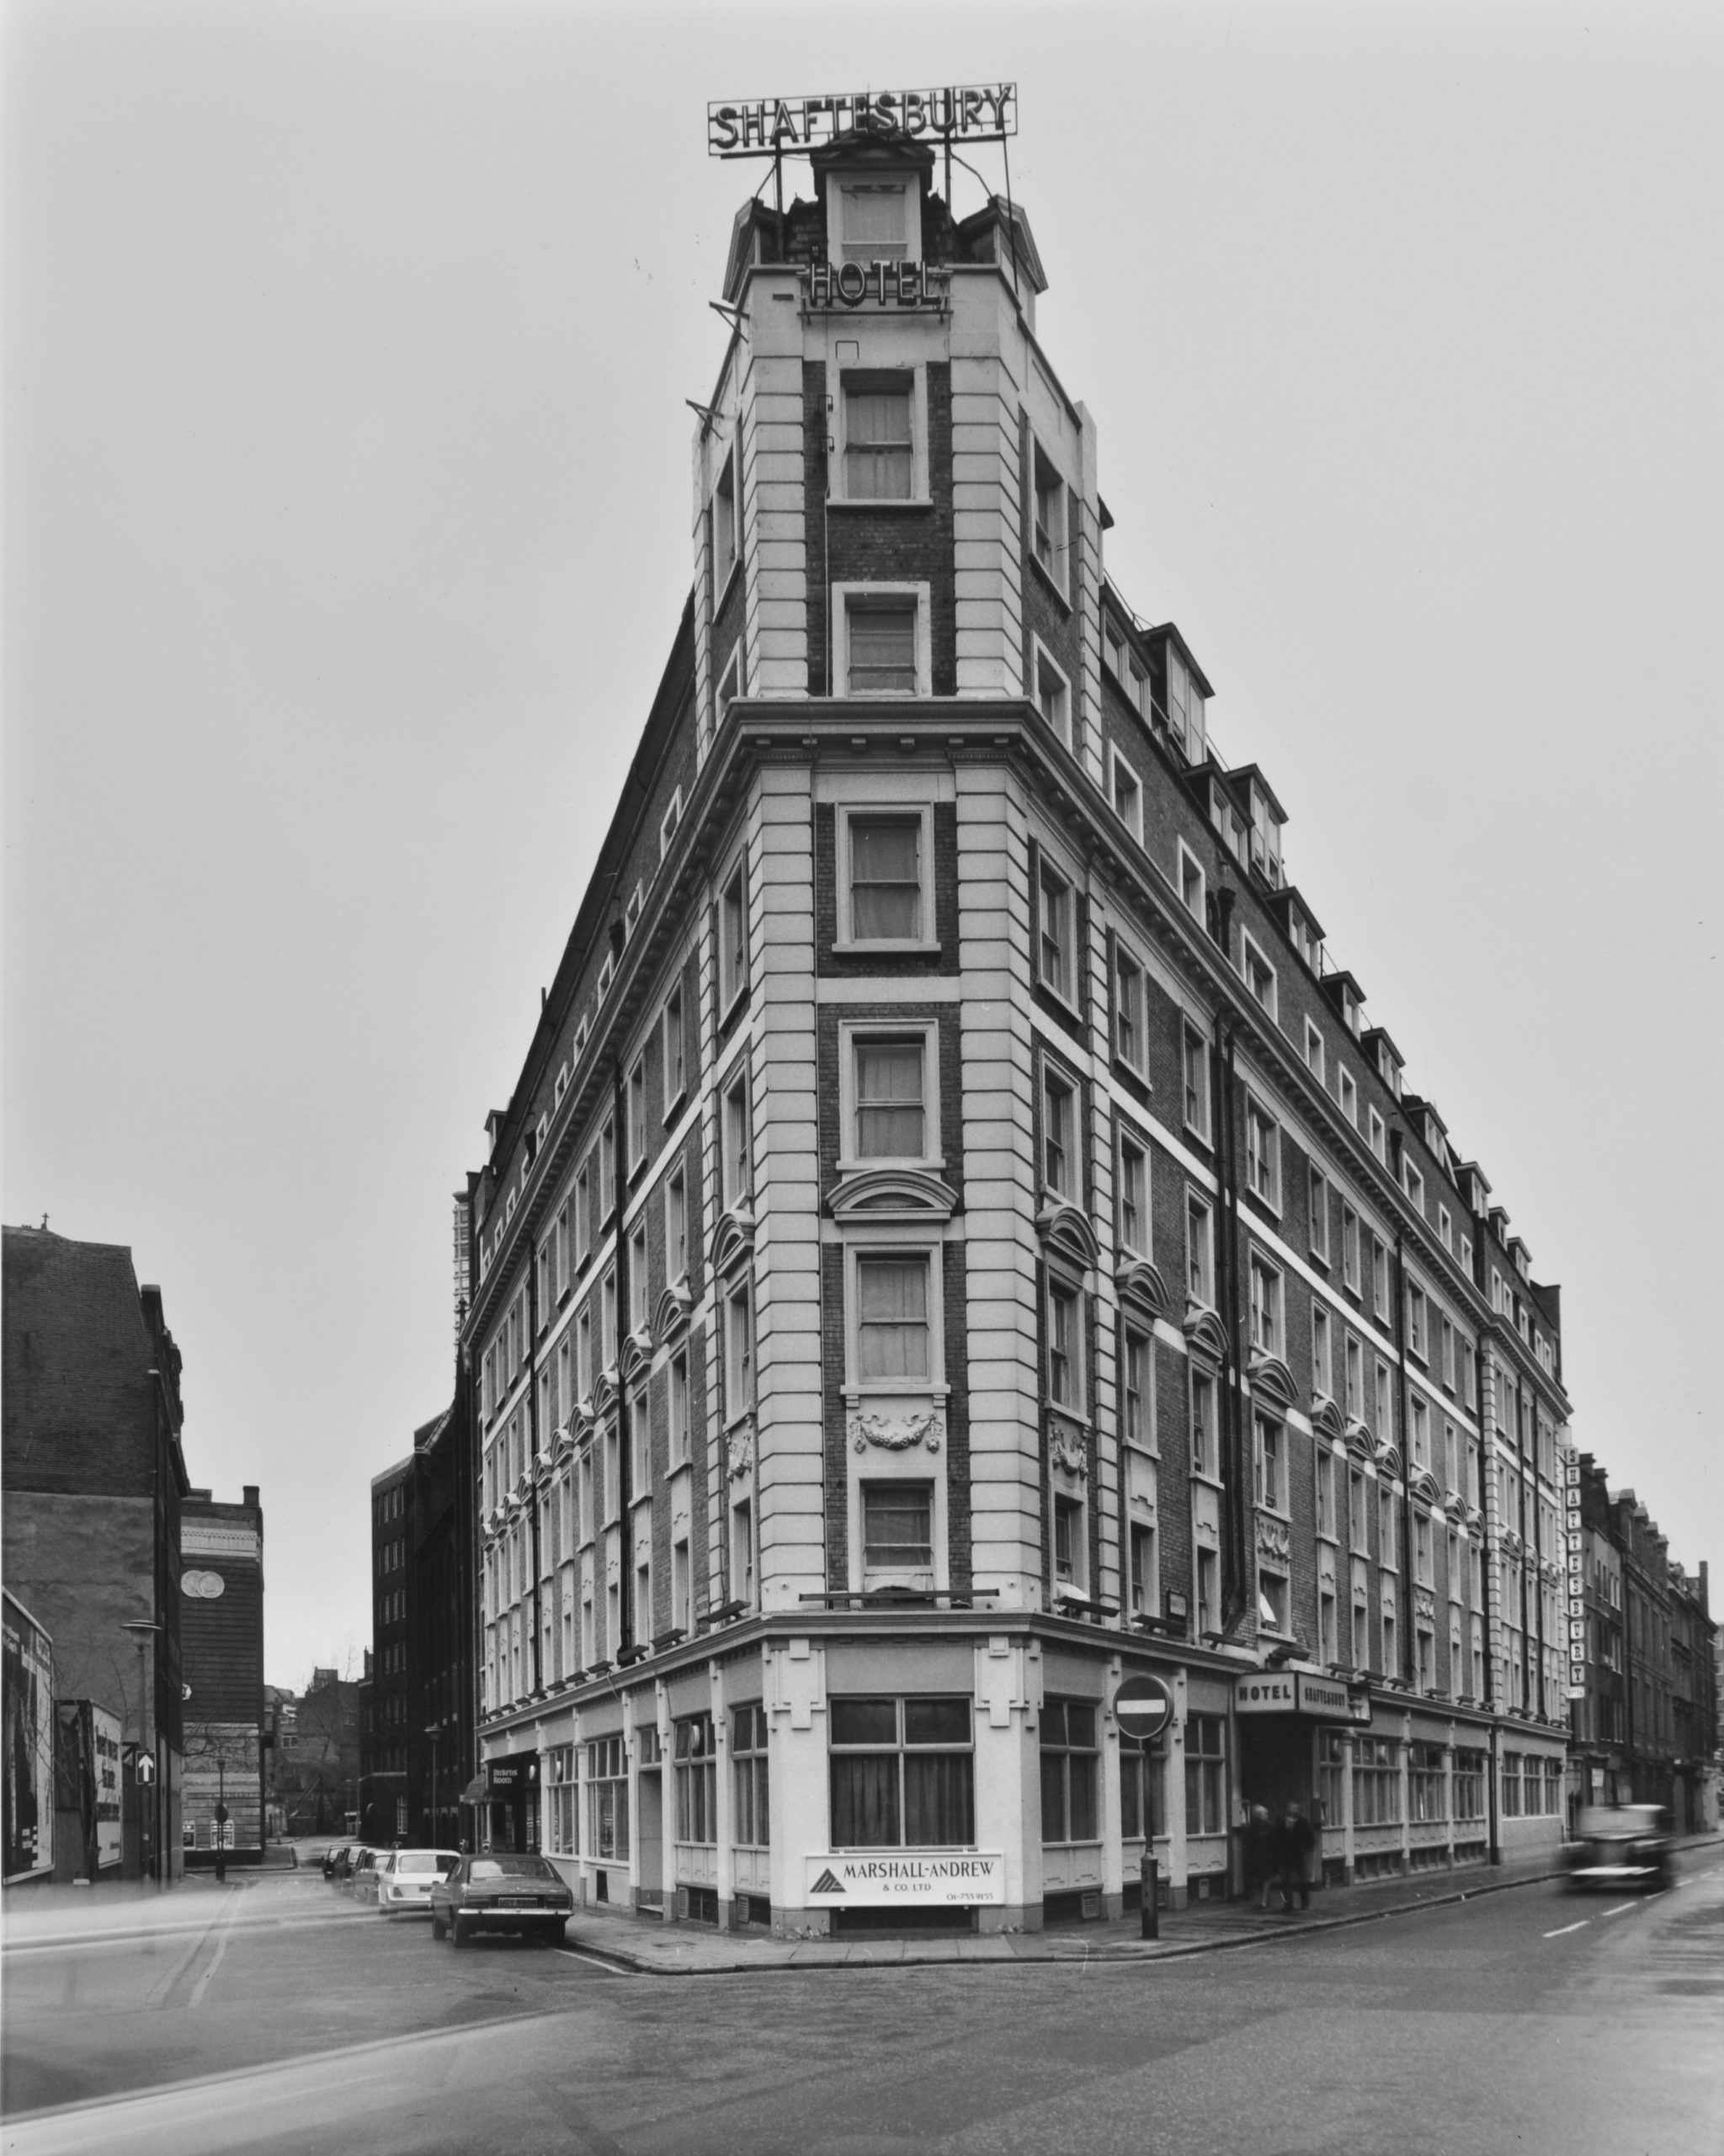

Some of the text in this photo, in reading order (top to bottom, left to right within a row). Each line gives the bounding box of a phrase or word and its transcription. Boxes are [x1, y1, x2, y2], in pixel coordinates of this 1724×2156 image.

[716, 85, 1012, 149] SHAFTESBURY
[810, 260, 939, 306] HOTEL
[1568, 1449, 1582, 1681] SHAFTESBURY
[1238, 1685, 1291, 1701] HOTEL
